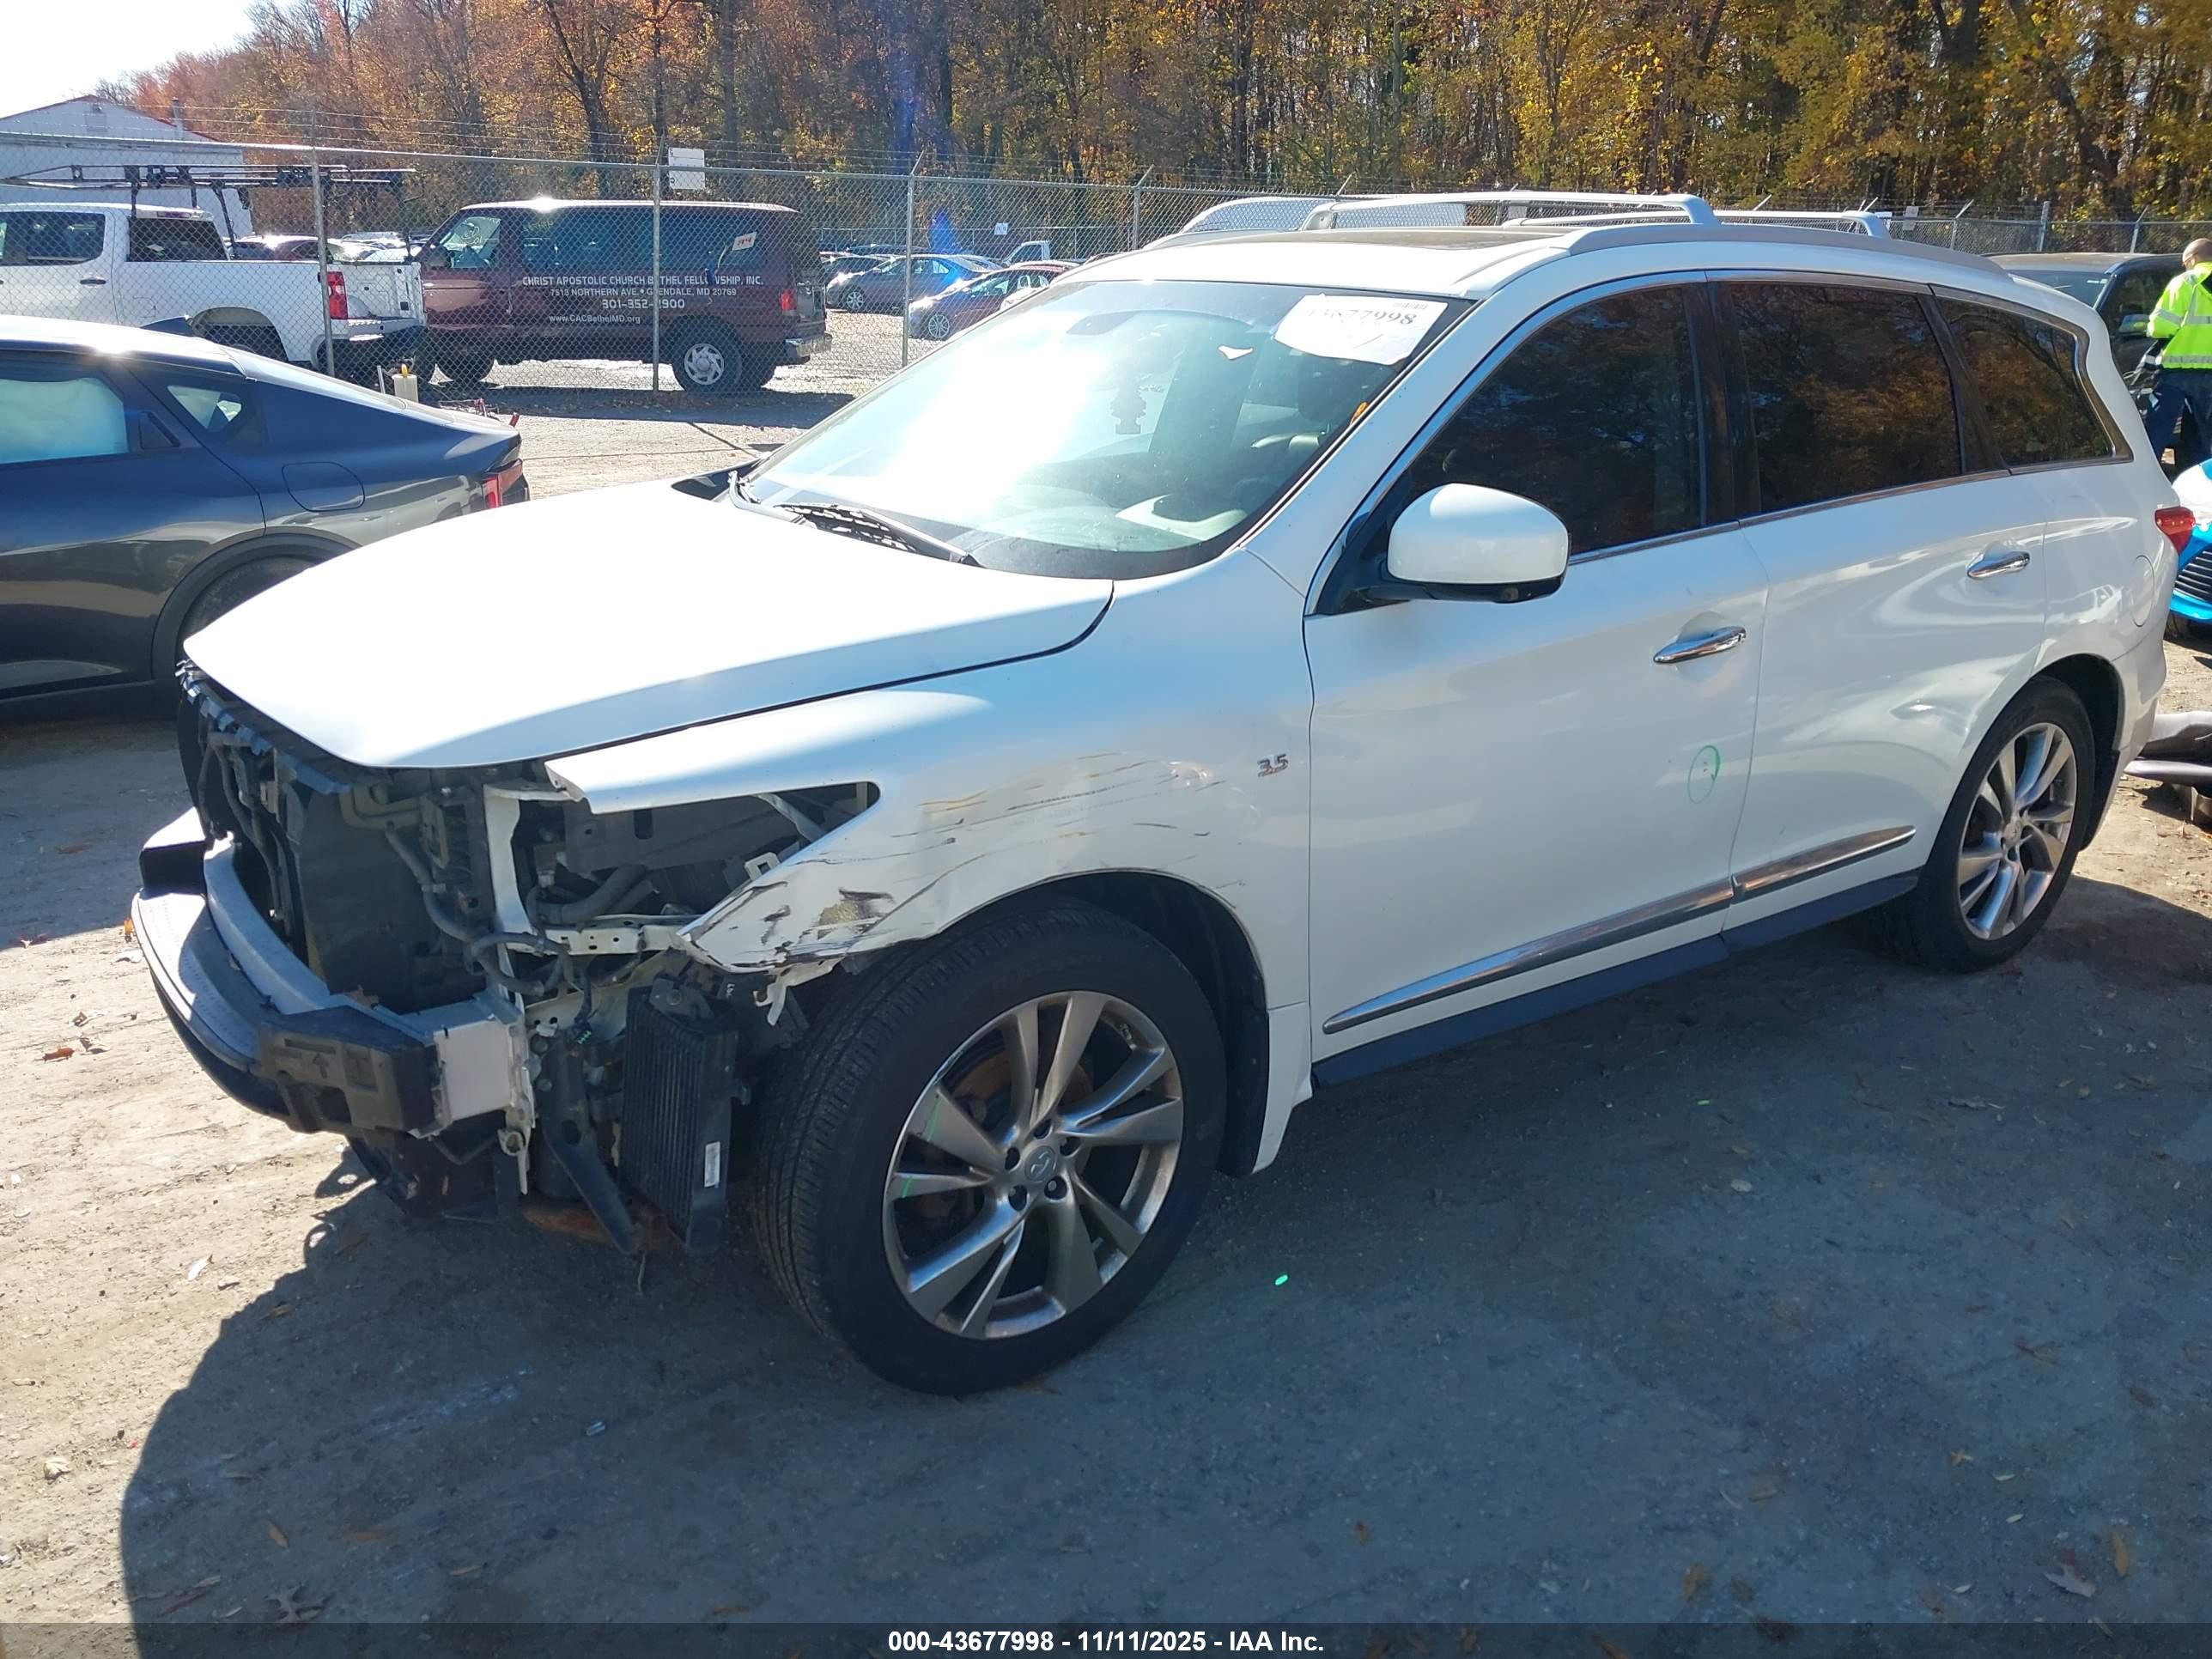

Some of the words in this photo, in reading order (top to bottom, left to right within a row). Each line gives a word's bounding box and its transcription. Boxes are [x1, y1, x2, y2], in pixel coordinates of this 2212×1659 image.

[522, 276, 554, 286] CHRIST
[556, 276, 607, 285] APOSTOLIC
[610, 276, 645, 285] CHURCH
[647, 276, 682, 285] BTHEL
[746, 276, 763, 285] INC.
[696, 288, 711, 296] MD
[602, 299, 685, 309] 301-352-900
[549, 315, 641, 324] www.CACBethelMD.org
